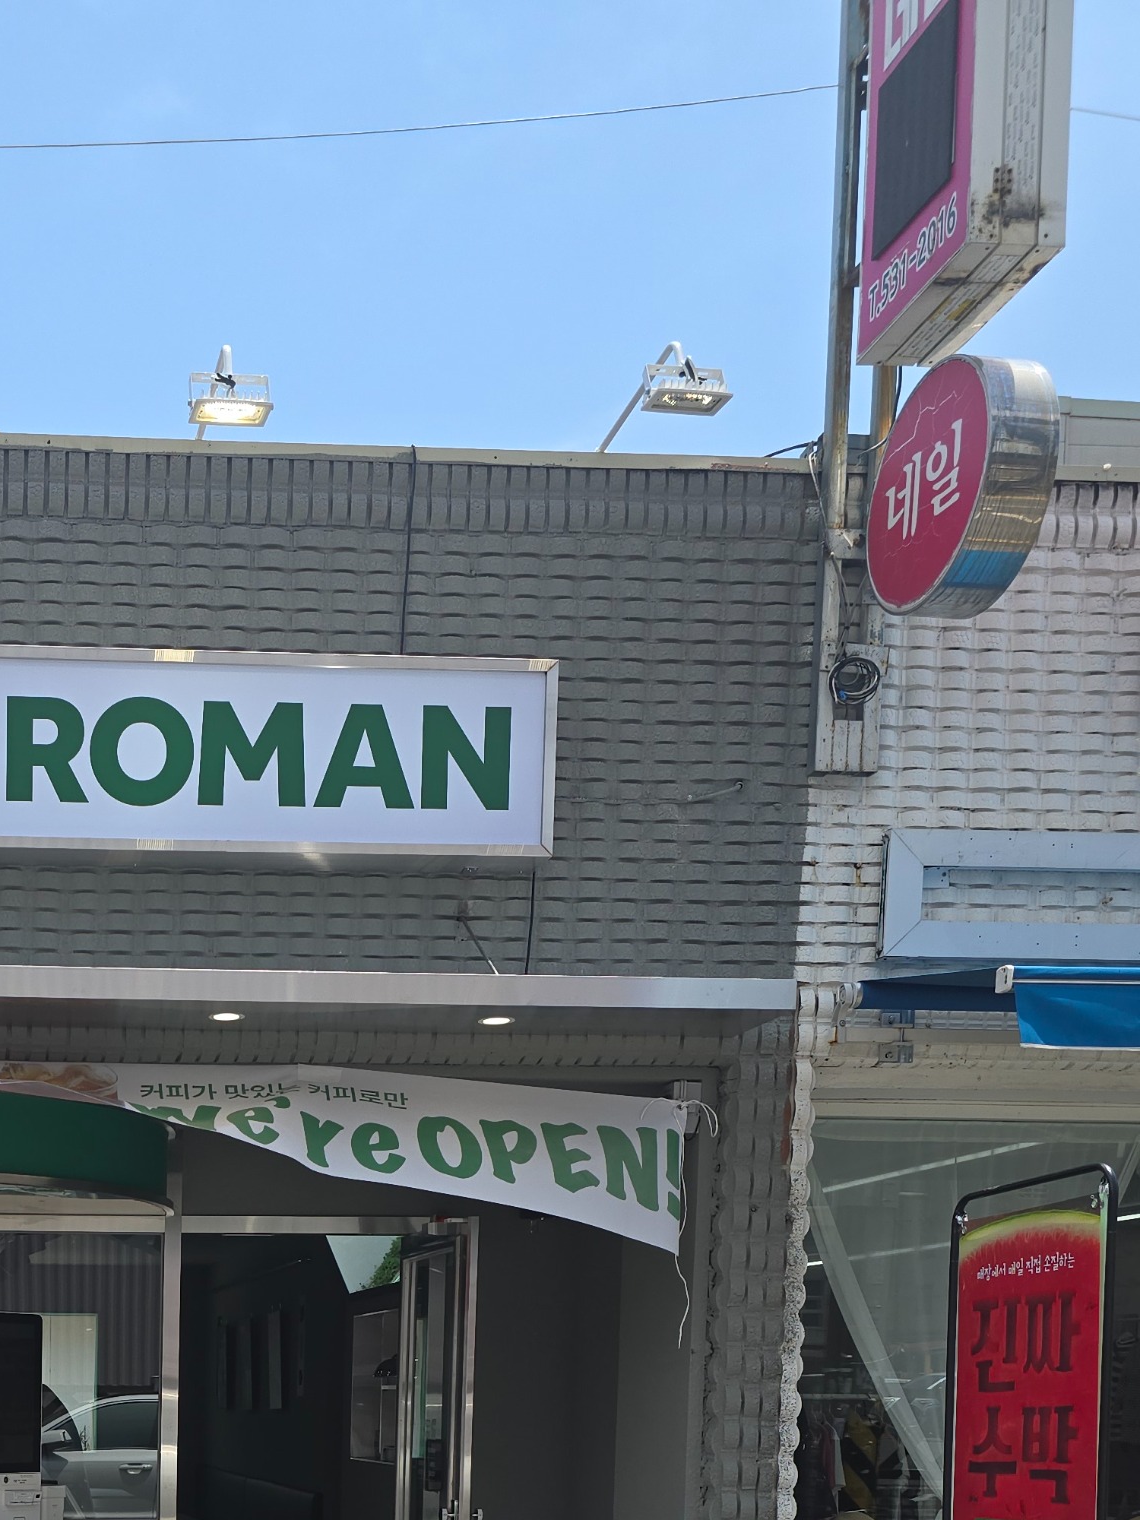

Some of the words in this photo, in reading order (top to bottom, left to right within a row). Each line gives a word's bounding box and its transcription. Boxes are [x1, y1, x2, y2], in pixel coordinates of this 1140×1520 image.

[868, 190, 958, 322] T.531-2016
[885, 418, 963, 541] 네일
[4, 695, 513, 811] ROMAN
[140, 1083, 217, 1100] 커피가
[307, 1082, 409, 1110] 커피로만
[417, 1115, 681, 1221] OPEN!
[976, 1262, 1006, 1281] 매장에서
[1008, 1257, 1024, 1276] 매일
[1025, 1254, 1041, 1275] 직접
[1043, 1251, 1075, 1272] 손질하는
[971, 1290, 1082, 1393] 진짜
[968, 1405, 1080, 1504] 수박
